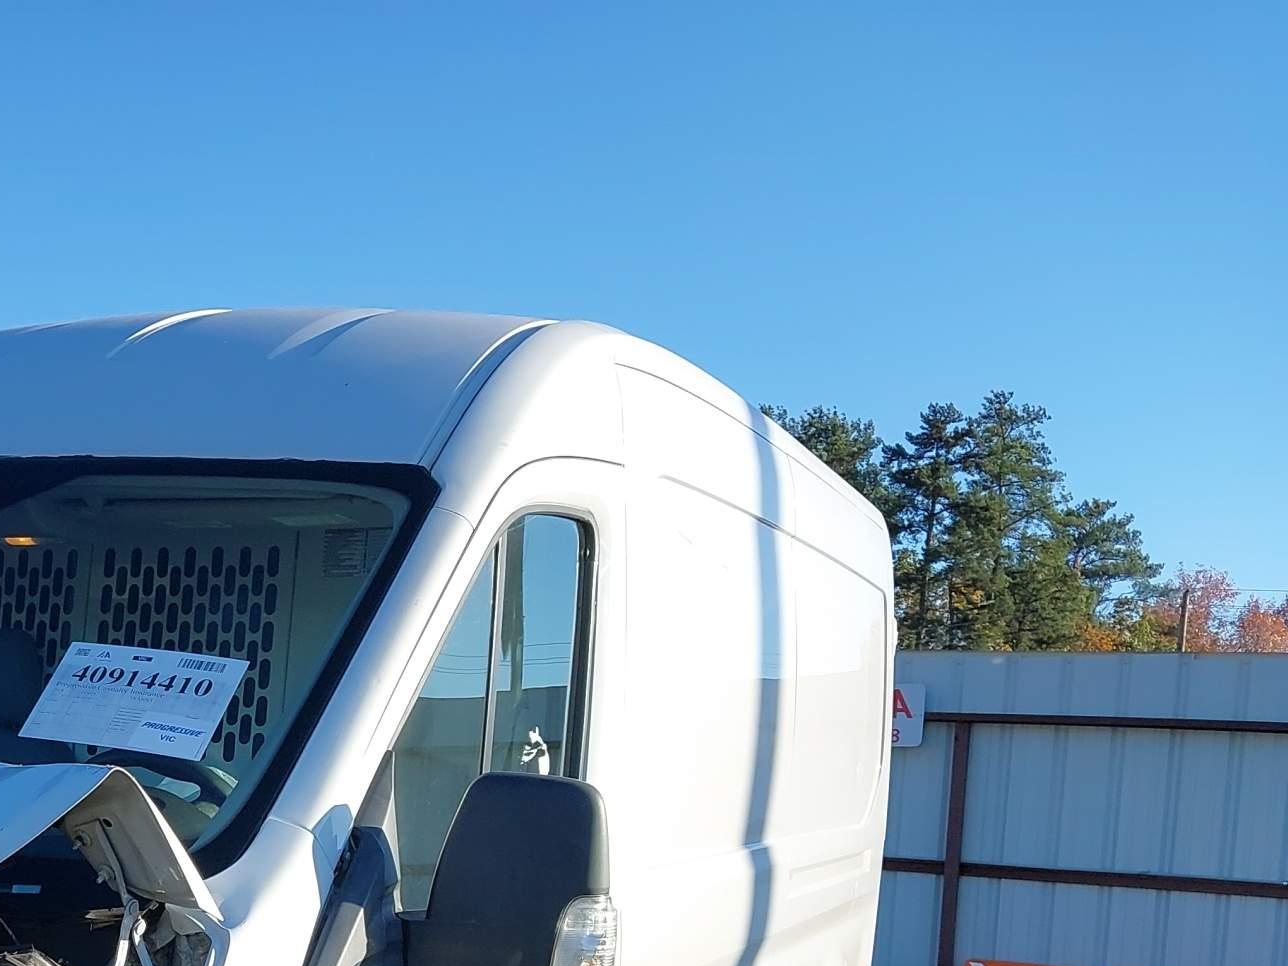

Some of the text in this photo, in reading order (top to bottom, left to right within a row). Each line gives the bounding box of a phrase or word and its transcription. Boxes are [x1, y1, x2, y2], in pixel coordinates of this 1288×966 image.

[72, 664, 214, 698] 40914410
[141, 721, 206, 738] PROGRESSIVE
[160, 734, 176, 743] VIC
